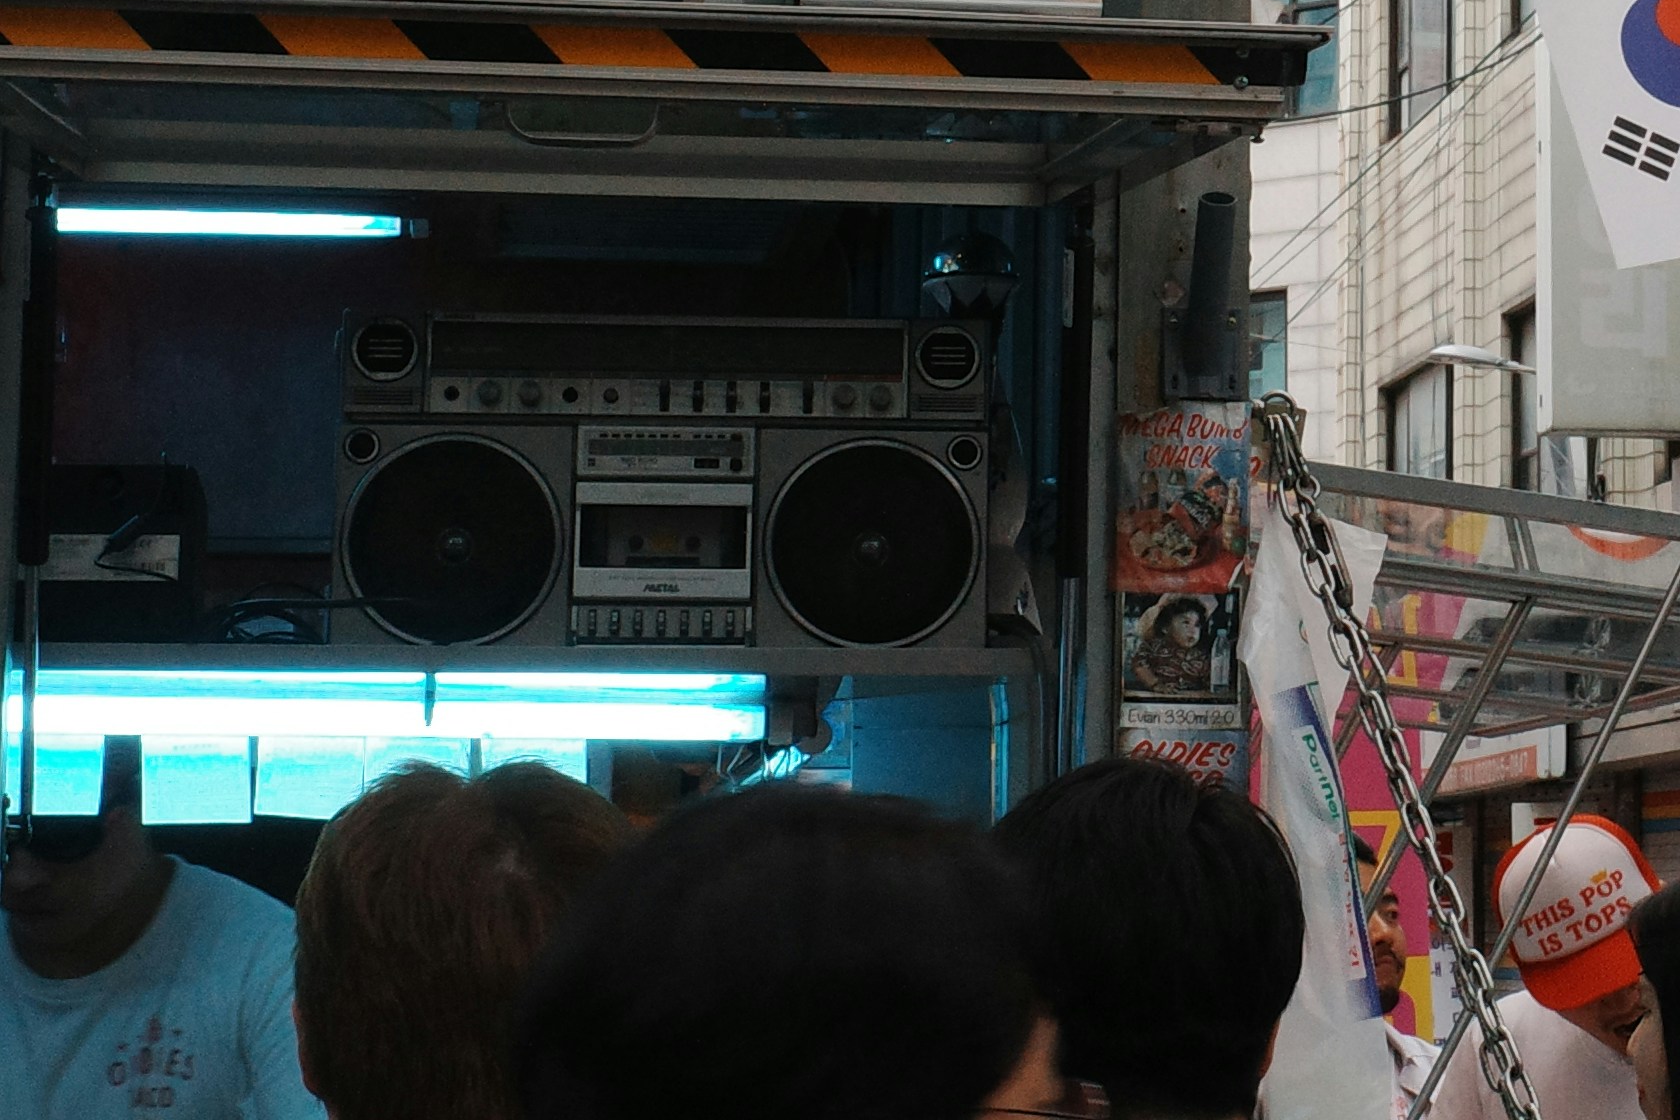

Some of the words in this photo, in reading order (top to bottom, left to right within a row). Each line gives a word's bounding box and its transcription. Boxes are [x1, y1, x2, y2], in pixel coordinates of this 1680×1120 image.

[1119, 411, 1183, 438] MEGA
[1146, 444, 1220, 470] SNACK
[1519, 898, 1575, 940] THIS
[1581, 868, 1626, 911] POP
[1538, 928, 1565, 957] IS
[1566, 896, 1634, 944] TOPS
